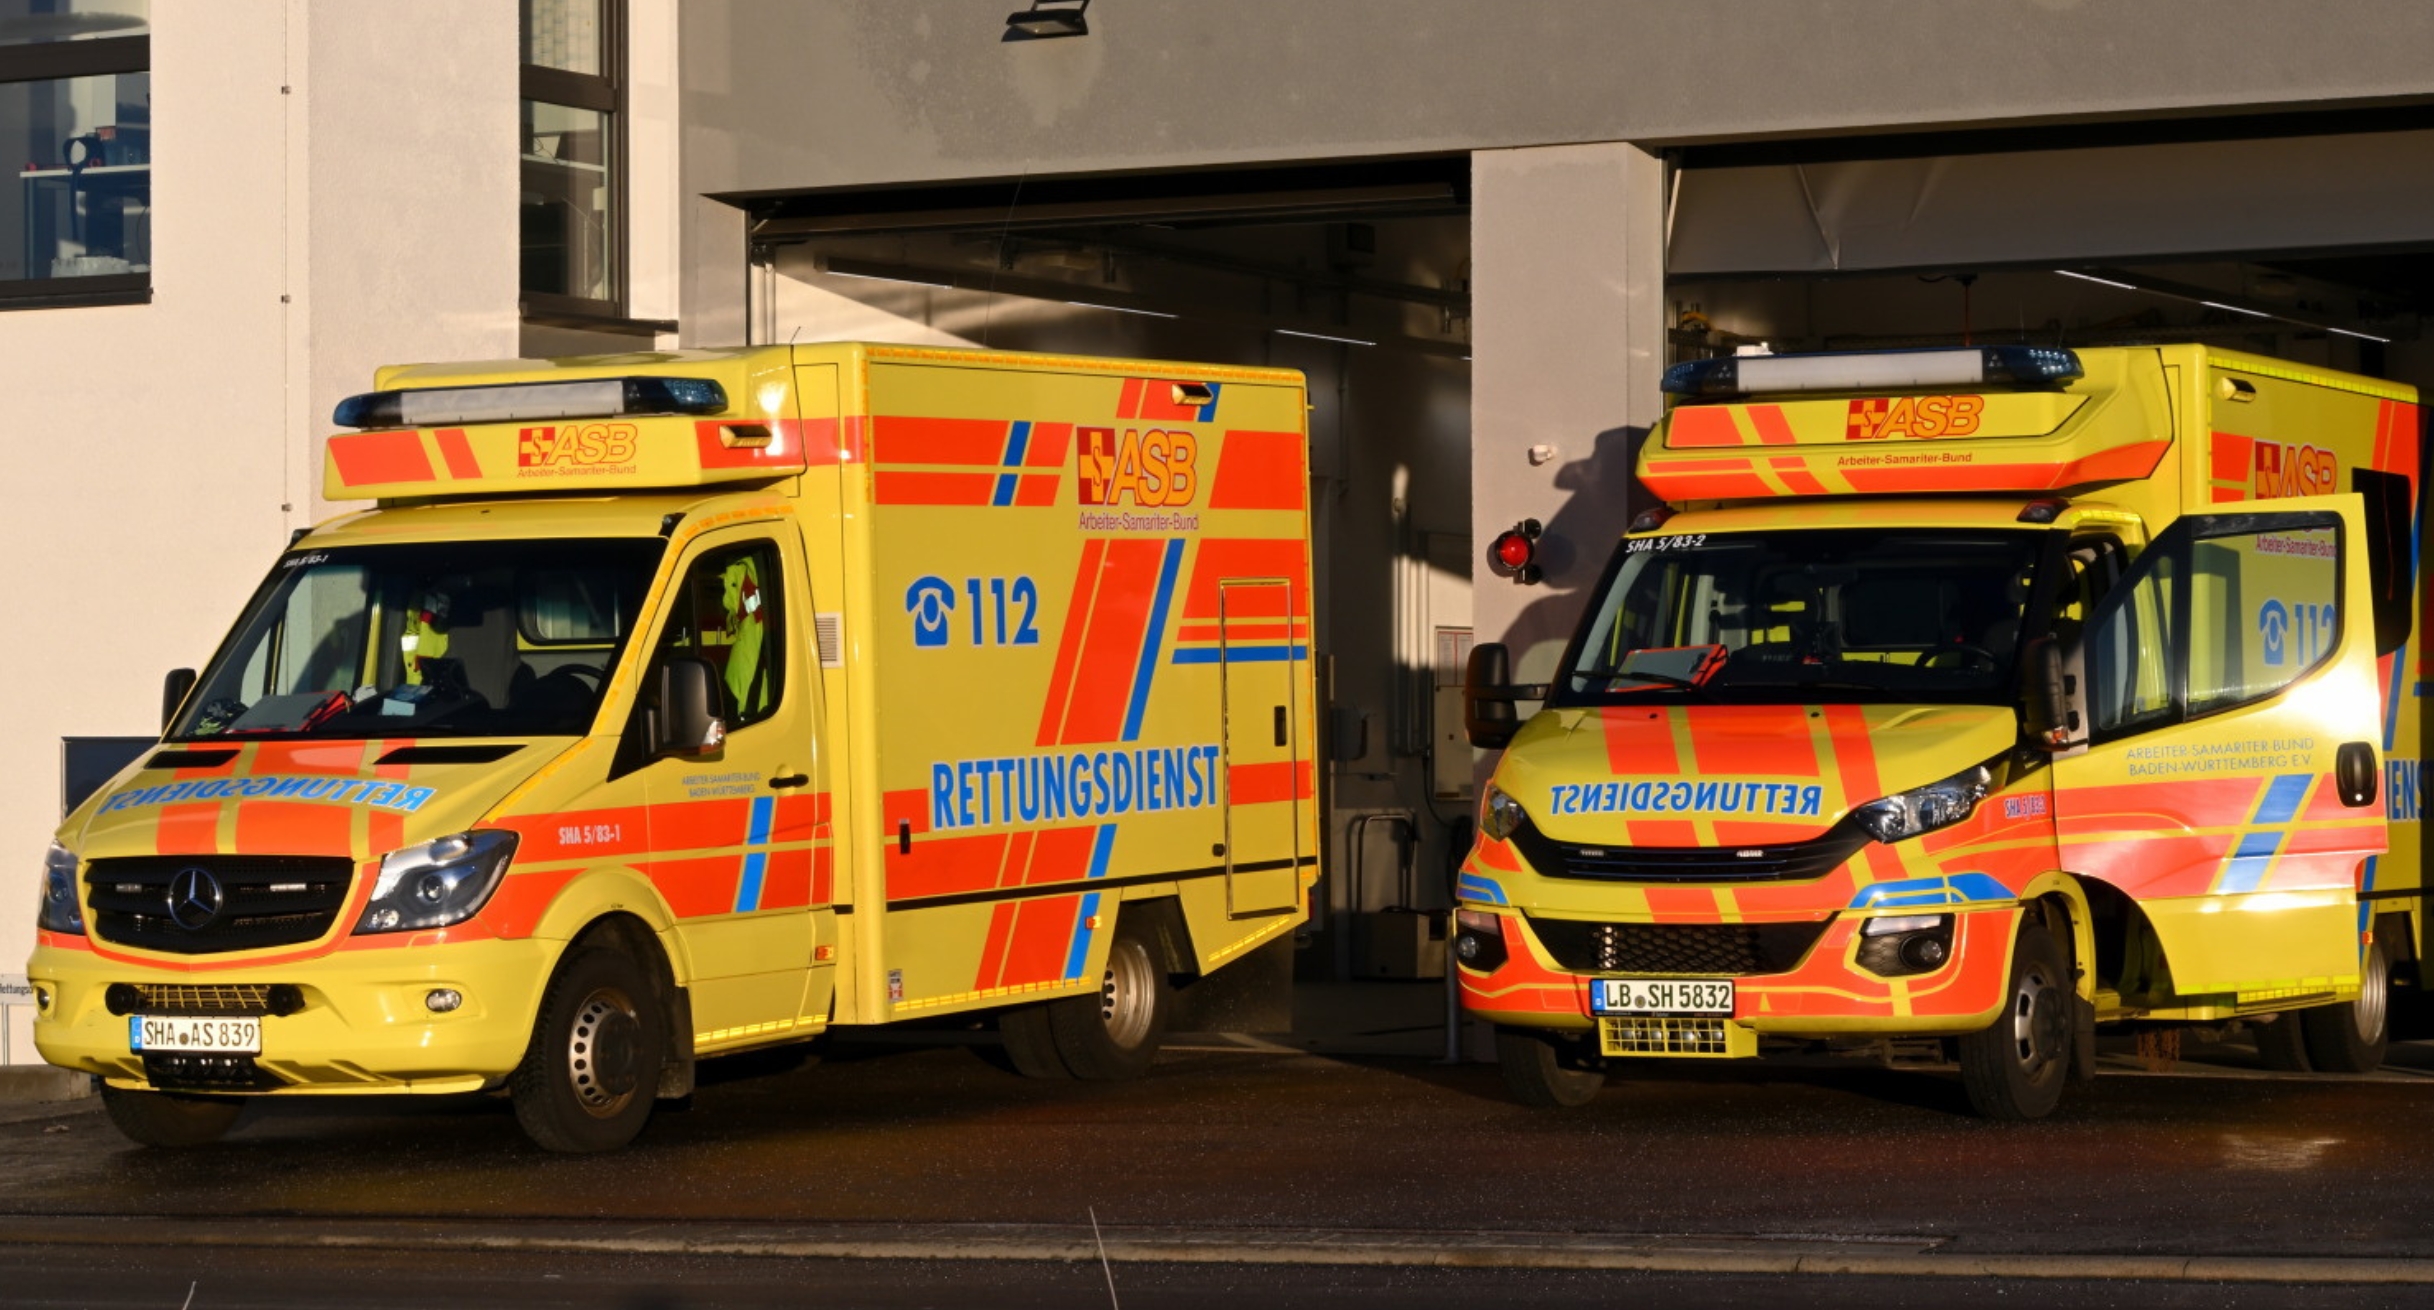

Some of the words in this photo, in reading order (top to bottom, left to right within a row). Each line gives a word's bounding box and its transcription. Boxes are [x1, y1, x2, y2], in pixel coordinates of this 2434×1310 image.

[1875, 395, 1985, 439] ASB
[543, 423, 638, 465] ASB
[1106, 428, 1197, 508] ASB
[1837, 452, 1973, 466] Arbeiter-Samariter-Bund
[1079, 511, 1199, 531] Arbeiter-Samariter-Bund
[1625, 538, 1654, 553] SHA
[1656, 533, 1707, 553] 5/83-2
[2256, 533, 2337, 557] Arbeiter-Samariter-Bun
[966, 576, 1039, 645] 112
[932, 746, 1219, 829] RETTUNGSDIENST
[558, 826, 581, 845] SHA
[583, 824, 621, 844] 5/83-1
[1606, 983, 1632, 1007] LB
[1648, 984, 1674, 1008] SH
[1679, 984, 1731, 1009] 5832
[144, 1020, 176, 1045] SHA
[191, 1022, 214, 1047] AS
[219, 1022, 255, 1047] 839
